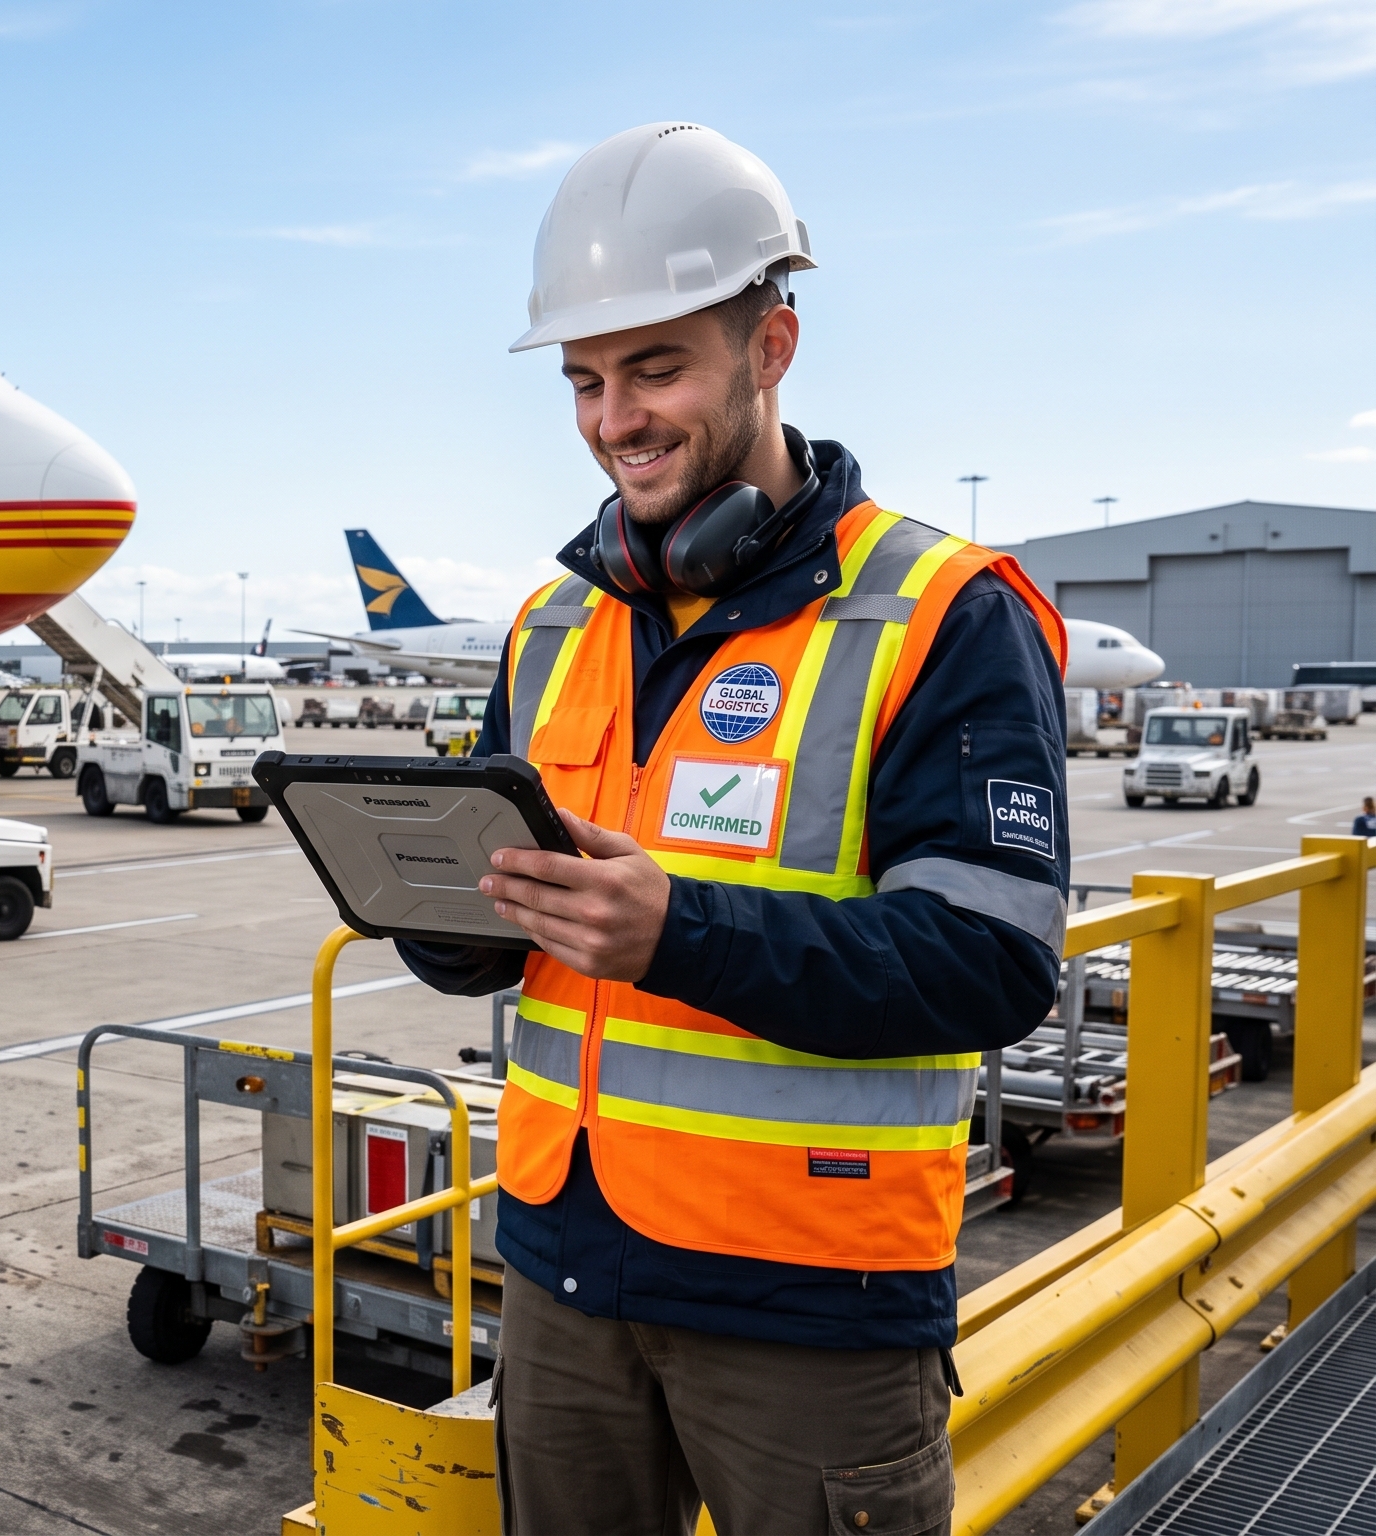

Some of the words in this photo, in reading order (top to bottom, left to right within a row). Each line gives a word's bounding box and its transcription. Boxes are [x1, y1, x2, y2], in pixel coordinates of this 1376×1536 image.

[720, 687, 766, 701] GLOBAL
[709, 698, 769, 714] LOGISTICS
[1010, 791, 1037, 809] AIR
[670, 812, 763, 836] CONFIRMED
[996, 807, 1050, 831] CARGO
